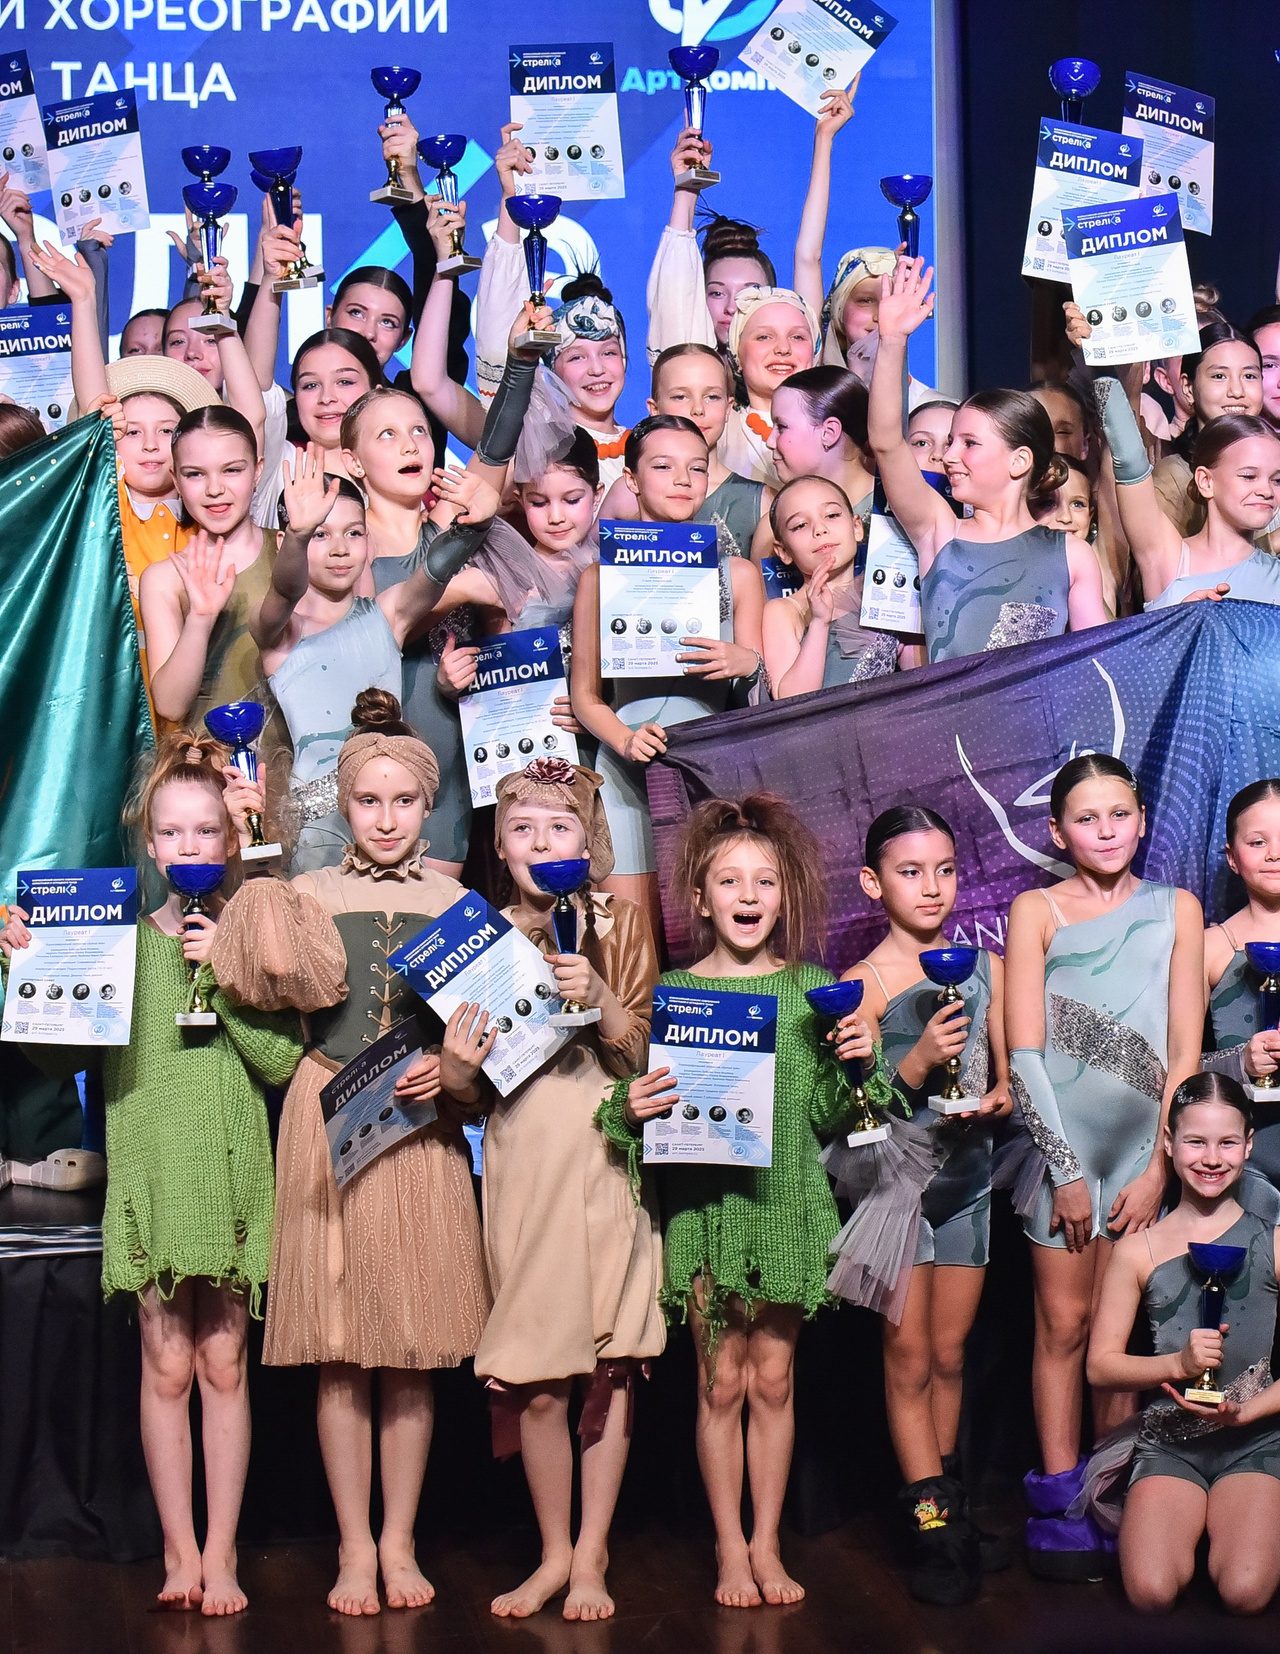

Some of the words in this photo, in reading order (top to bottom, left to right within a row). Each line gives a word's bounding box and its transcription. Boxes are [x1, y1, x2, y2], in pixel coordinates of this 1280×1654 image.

[44, 0, 448, 33] ХОРЕОГРАФИИ
[812, 0, 874, 40] ИПЛОМ
[51, 61, 237, 109] ТАНЦА
[523, 75, 602, 93] ДИПЛОМ
[57, 118, 127, 146] ДИПЛОМ
[1136, 103, 1203, 135] ДИПЛОМ
[1050, 151, 1128, 180] ДИПЛОМ
[1081, 226, 1168, 255] ДИПЛОМ
[614, 548, 702, 564] ДИПЛОМ
[468, 661, 549, 692] ДИПЛОМ
[30, 904, 122, 925] ДИПЛОМ
[424, 923, 498, 990] ДИПЛОМ
[664, 1024, 758, 1047] ДИПЛОМ
[335, 1044, 408, 1112] ДИПЛОМ
